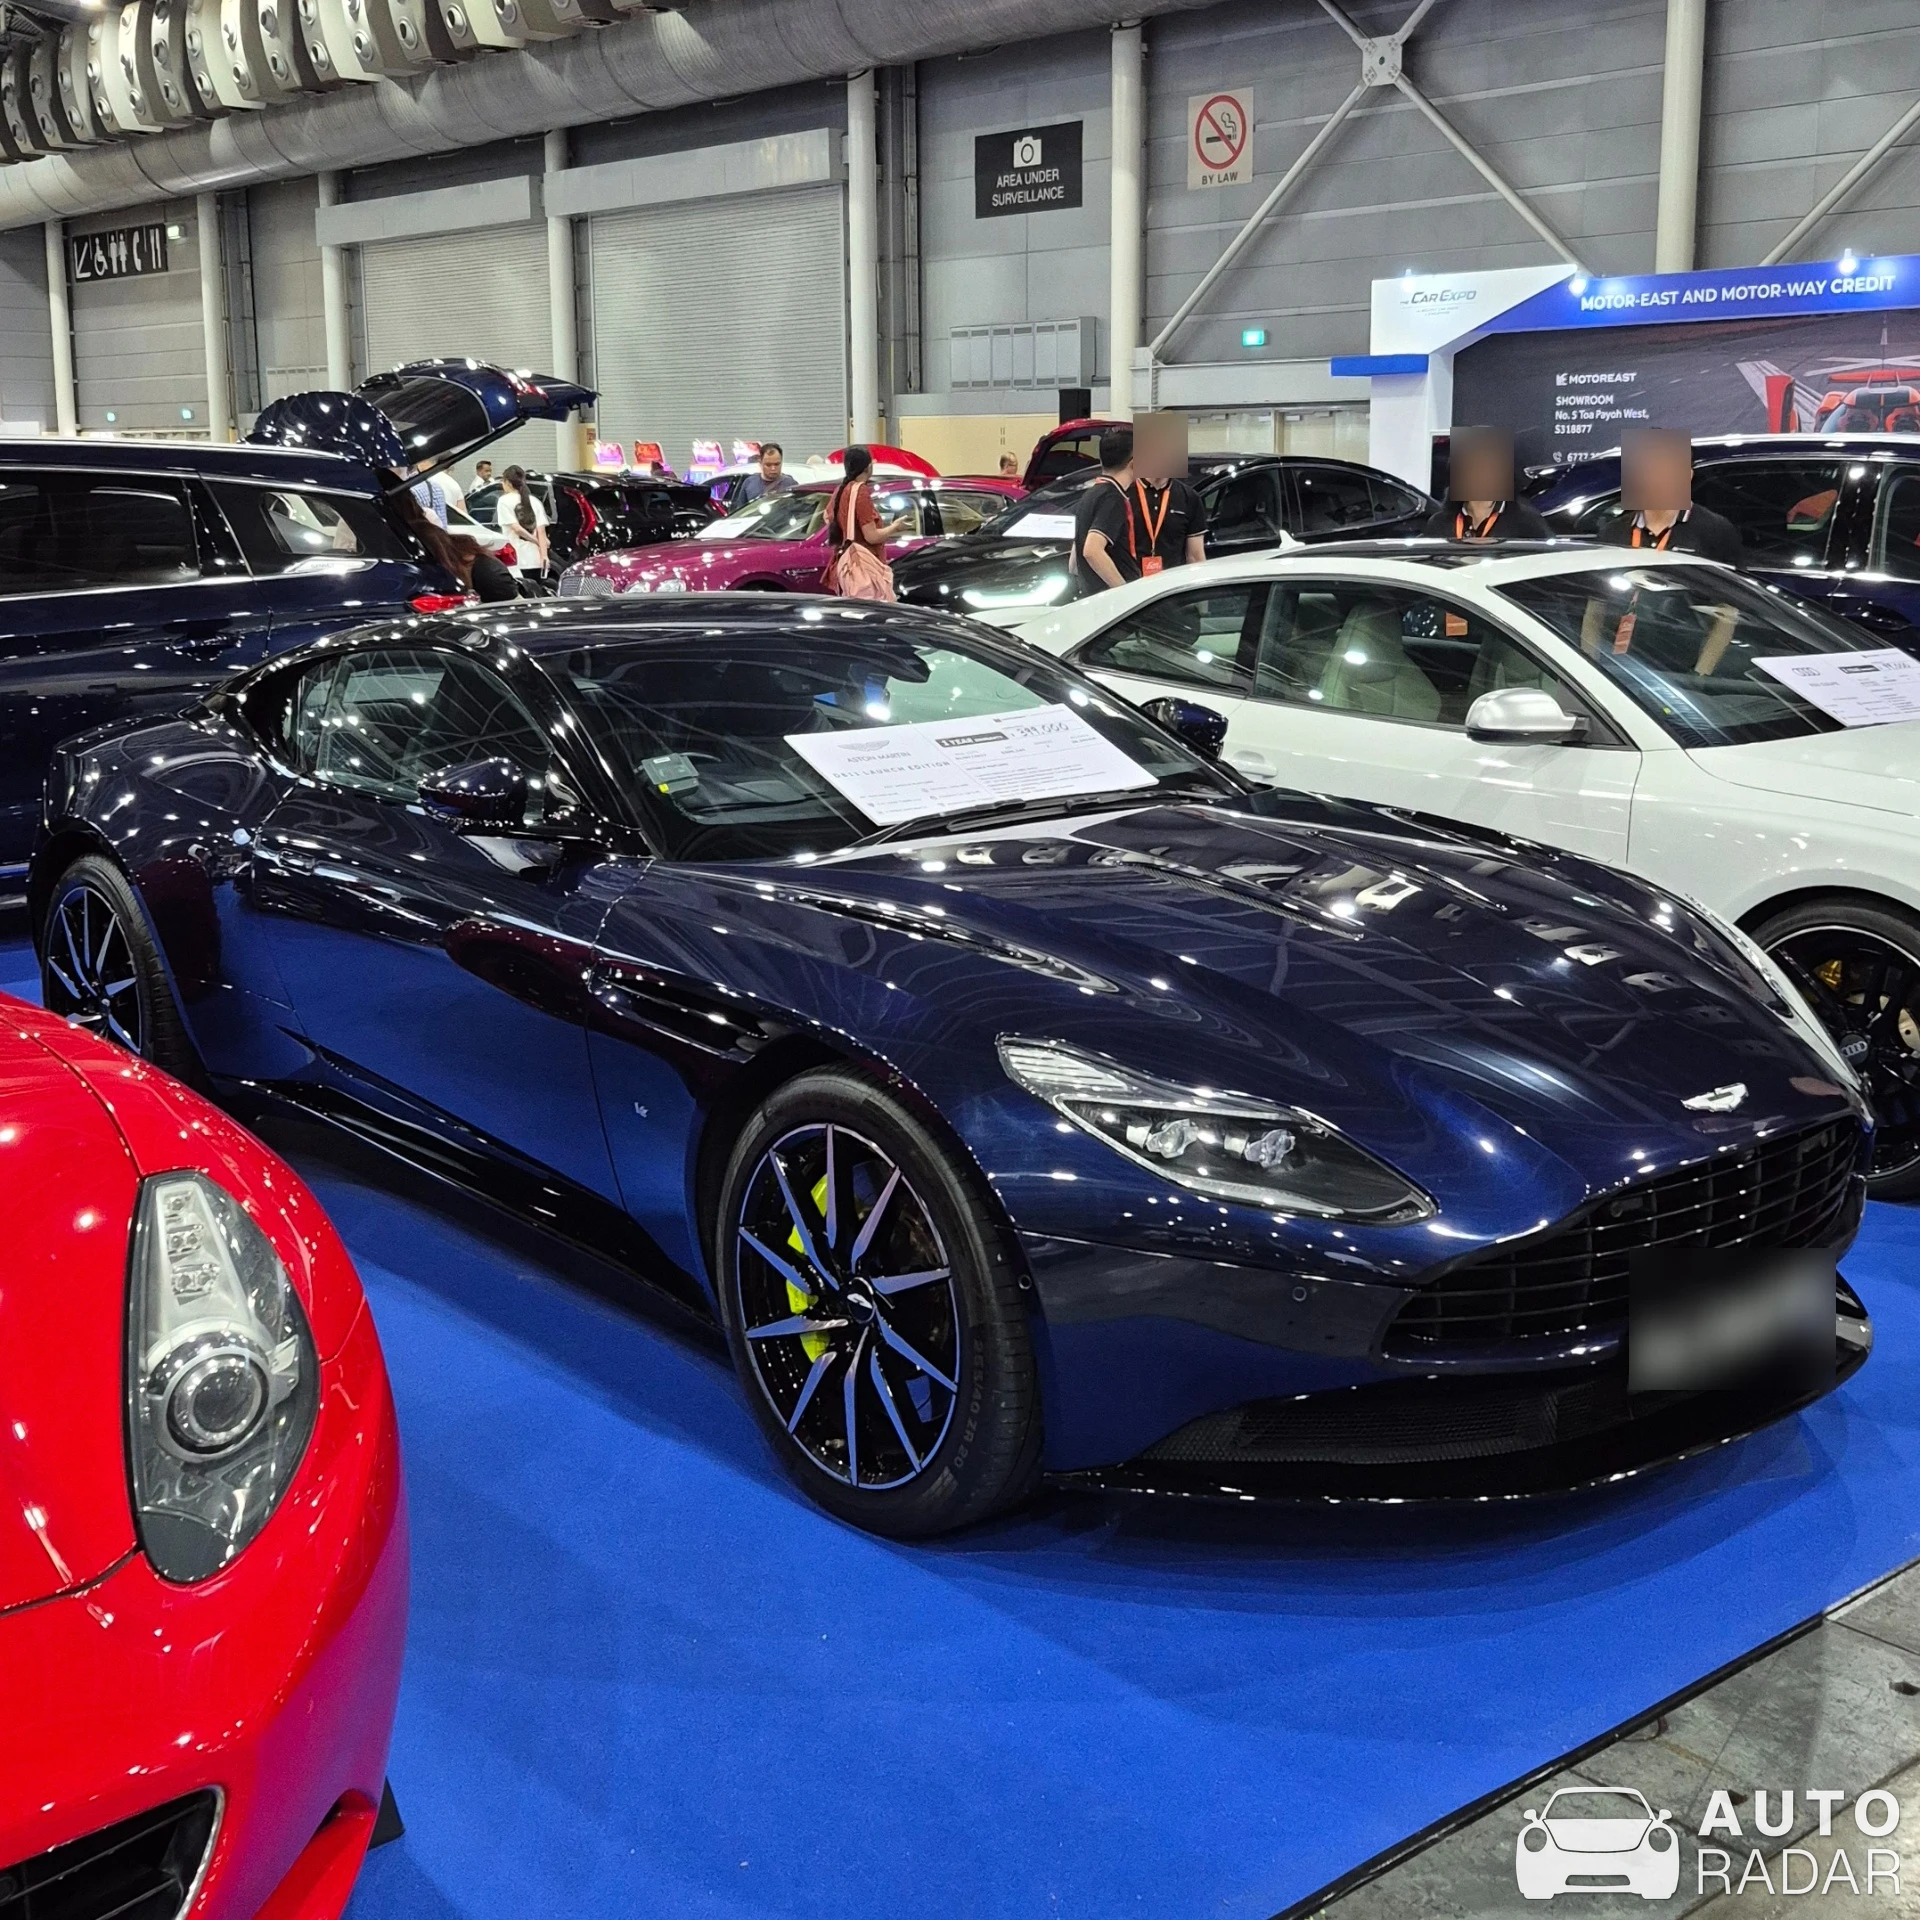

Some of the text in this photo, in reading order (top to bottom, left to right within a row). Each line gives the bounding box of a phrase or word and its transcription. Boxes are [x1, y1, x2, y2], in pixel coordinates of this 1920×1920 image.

[996, 168, 1060, 188] AREA UNDER
[1201, 171, 1239, 185] BY LAW
[991, 186, 1065, 207] SURVEILLANCE
[1580, 275, 1896, 311] MOTOR-EAST AND MOTOR-WAY CREDIT
[1568, 372, 1637, 384] MOTOREAST
[1555, 395, 1614, 406] SHOWROOM
[1554, 408, 1650, 421] No. 5 Toa Payoh West,
[1554, 424, 1593, 434] S318877
[847, 751, 912, 763] ASTON MARTIN
[864, 766, 905, 776] LAUNCH
[908, 760, 951, 771] EDITION
